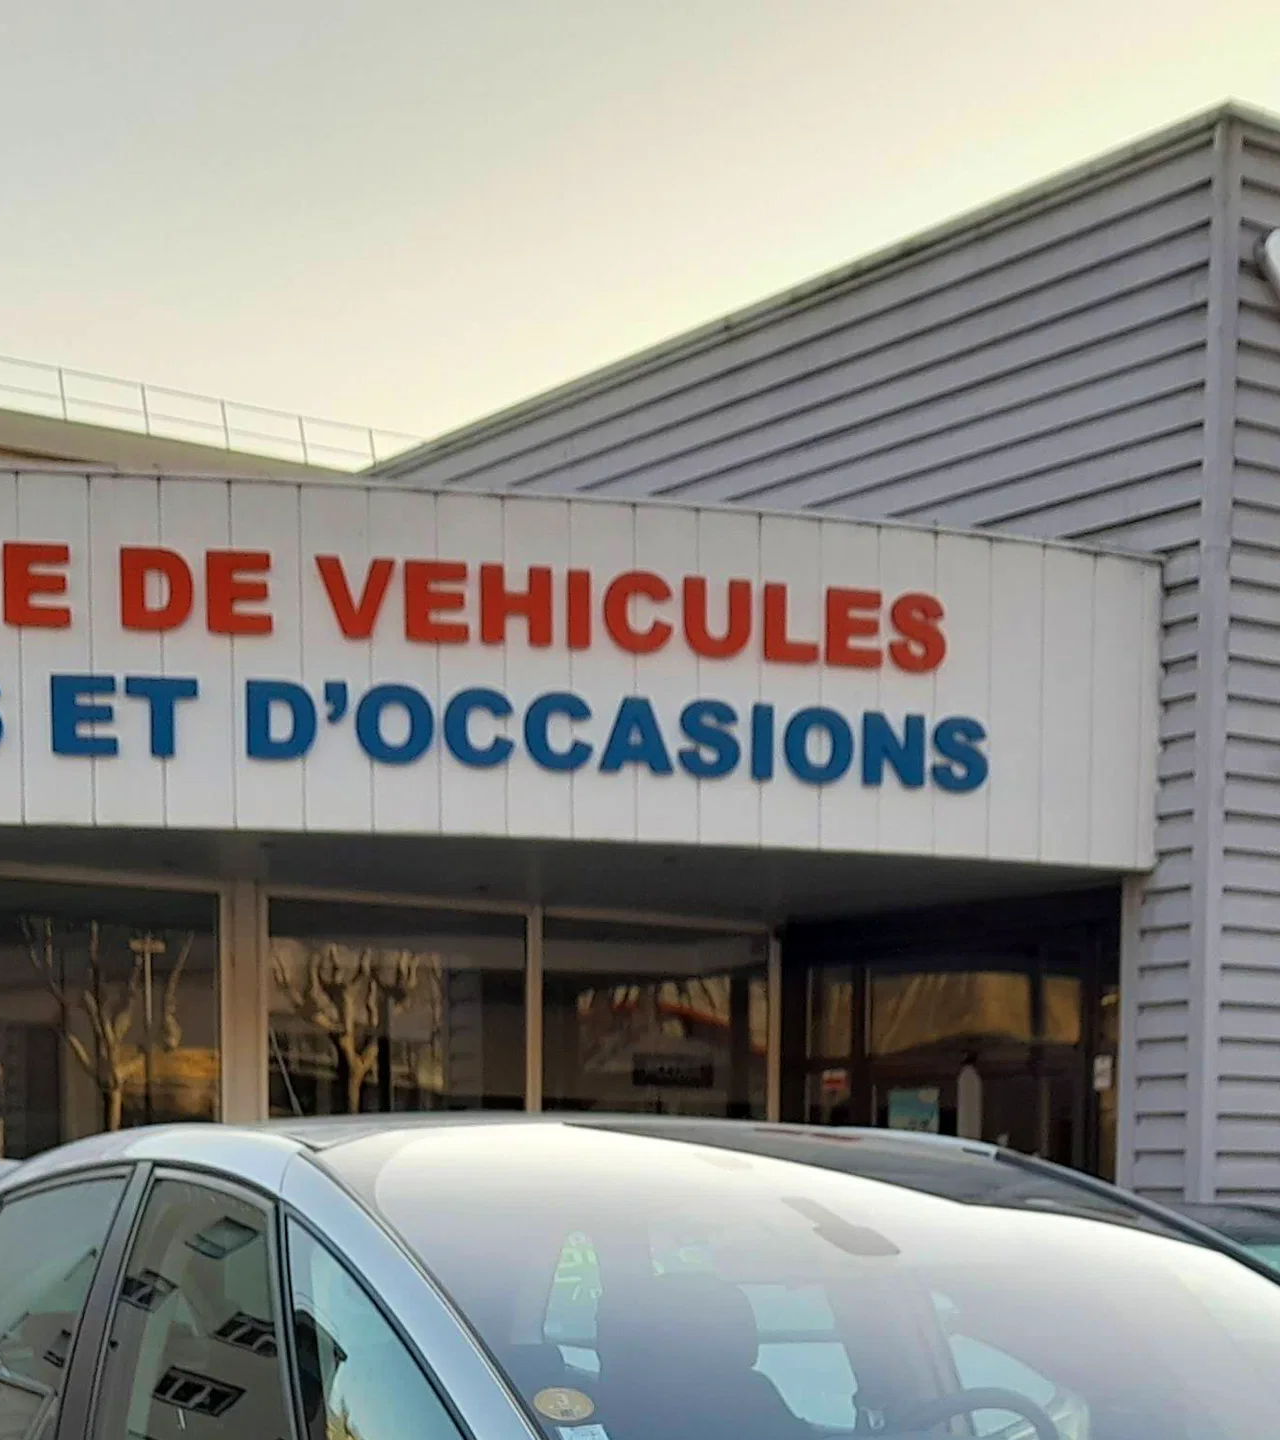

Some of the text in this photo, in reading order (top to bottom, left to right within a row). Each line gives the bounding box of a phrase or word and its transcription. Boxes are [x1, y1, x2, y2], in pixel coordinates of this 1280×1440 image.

[119, 545, 273, 636] DE
[316, 555, 946, 674] VEHICULES
[51, 673, 198, 758] ET
[244, 678, 989, 795] D'OCCASIONS
